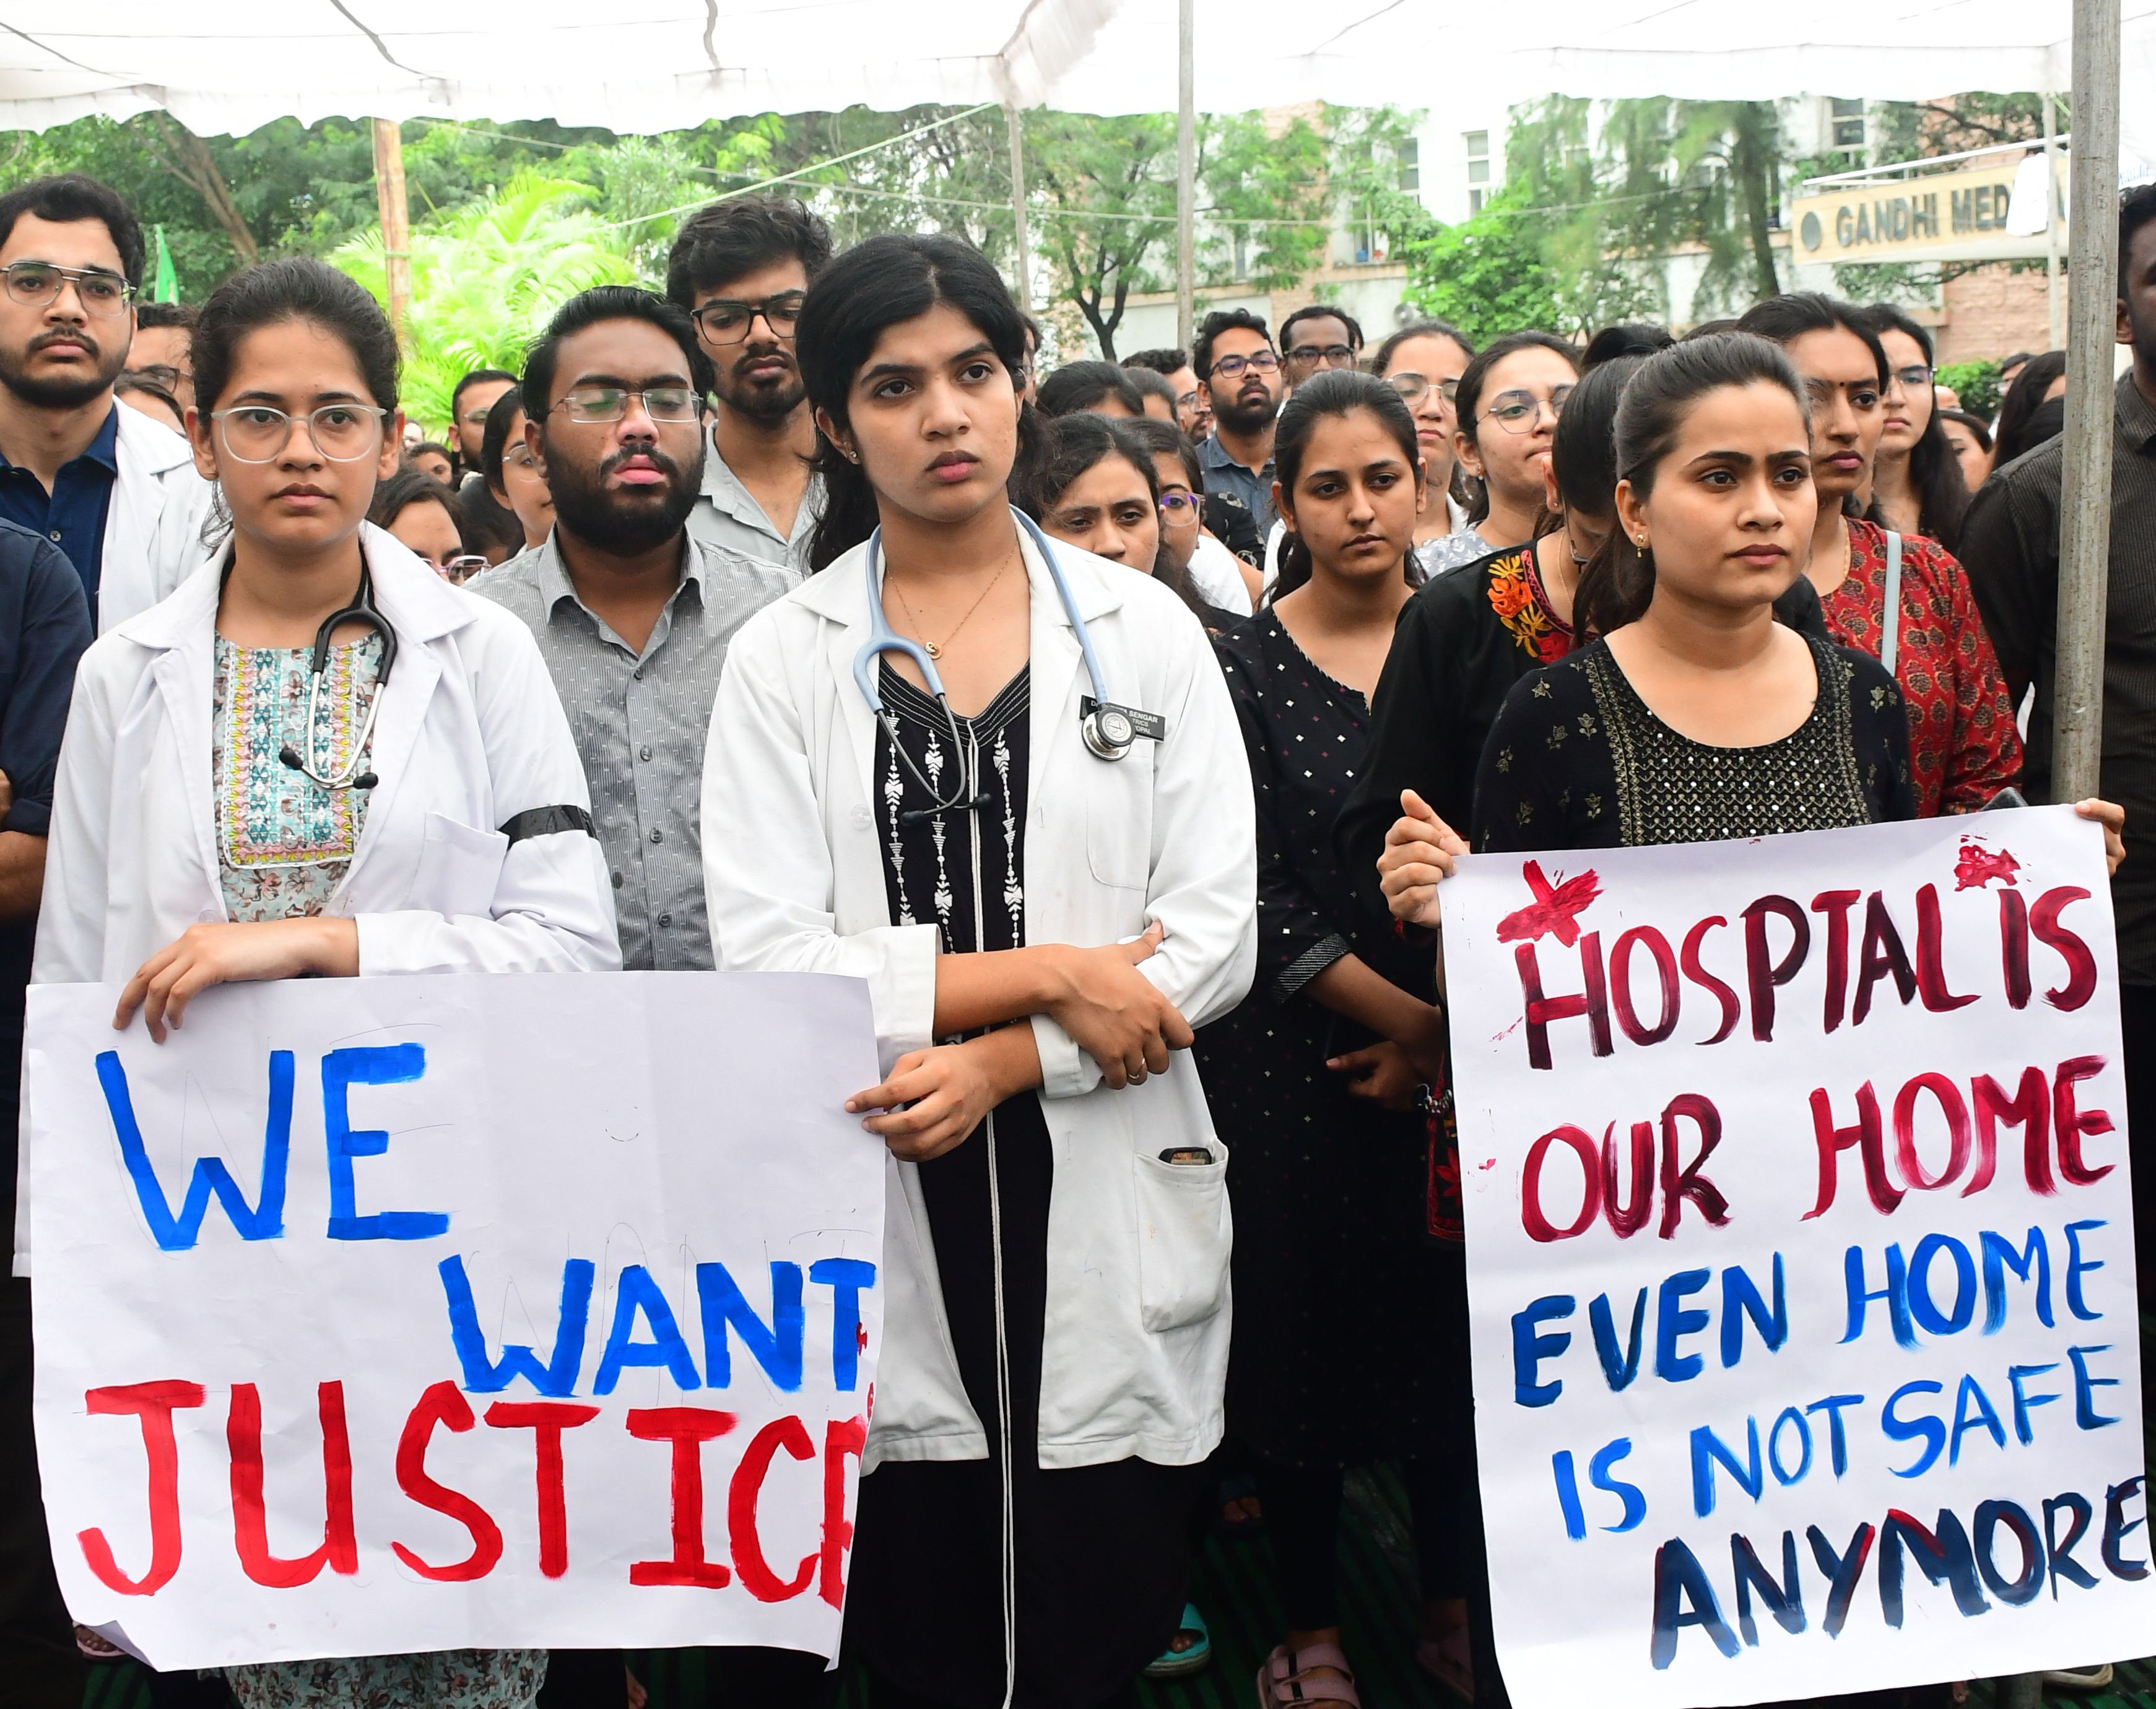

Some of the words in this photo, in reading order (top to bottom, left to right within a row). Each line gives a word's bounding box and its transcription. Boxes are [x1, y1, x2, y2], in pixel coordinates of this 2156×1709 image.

[1836, 193, 1939, 248] GANDHI
[1952, 183, 2012, 234] MED
[1129, 710, 1158, 723] SENGAR
[1132, 718, 1149, 727] TRICS
[1135, 725, 1152, 734] OPAL
[1515, 883, 1981, 1070] HOSPTAL
[1998, 886, 2097, 1012] IS
[95, 1043, 450, 1251] WE
[1522, 1094, 1730, 1242] OUR
[1802, 1056, 2115, 1220] HOME
[438, 1255, 876, 1398] WANT
[1511, 1252, 1788, 1407] EVEN
[1840, 1220, 2108, 1350] HOME
[1552, 1438, 1646, 1541] IS
[1690, 1394, 1864, 1518] NOT
[1882, 1346, 2120, 1478] SAFE
[1651, 1475, 2150, 1669] ANYMORE
